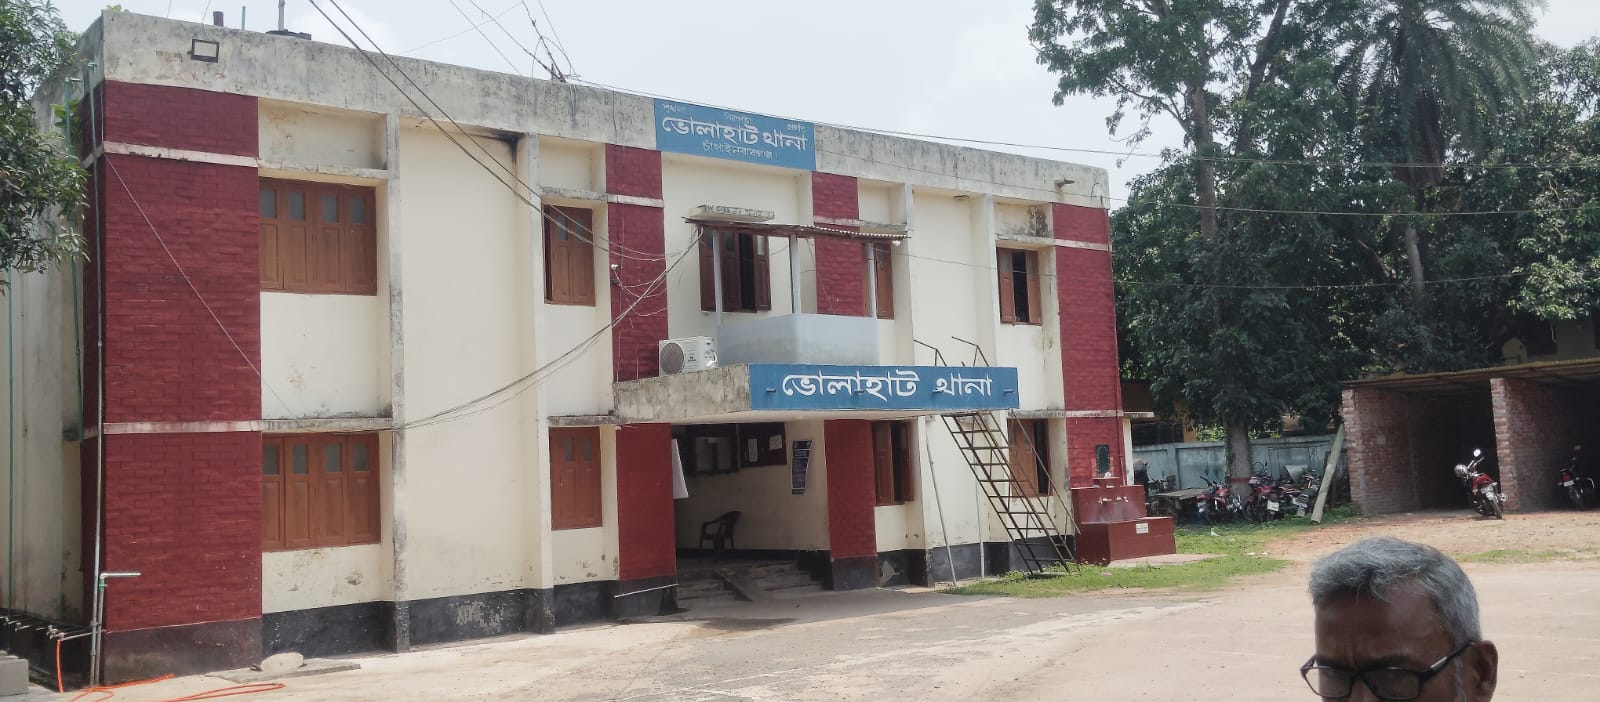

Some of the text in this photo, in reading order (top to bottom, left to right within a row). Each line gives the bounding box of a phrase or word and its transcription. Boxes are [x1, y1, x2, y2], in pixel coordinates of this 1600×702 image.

[662, 115, 808, 151] ভোলাহাট থানা
[782, 369, 992, 402] ভোলাহাট থানা
